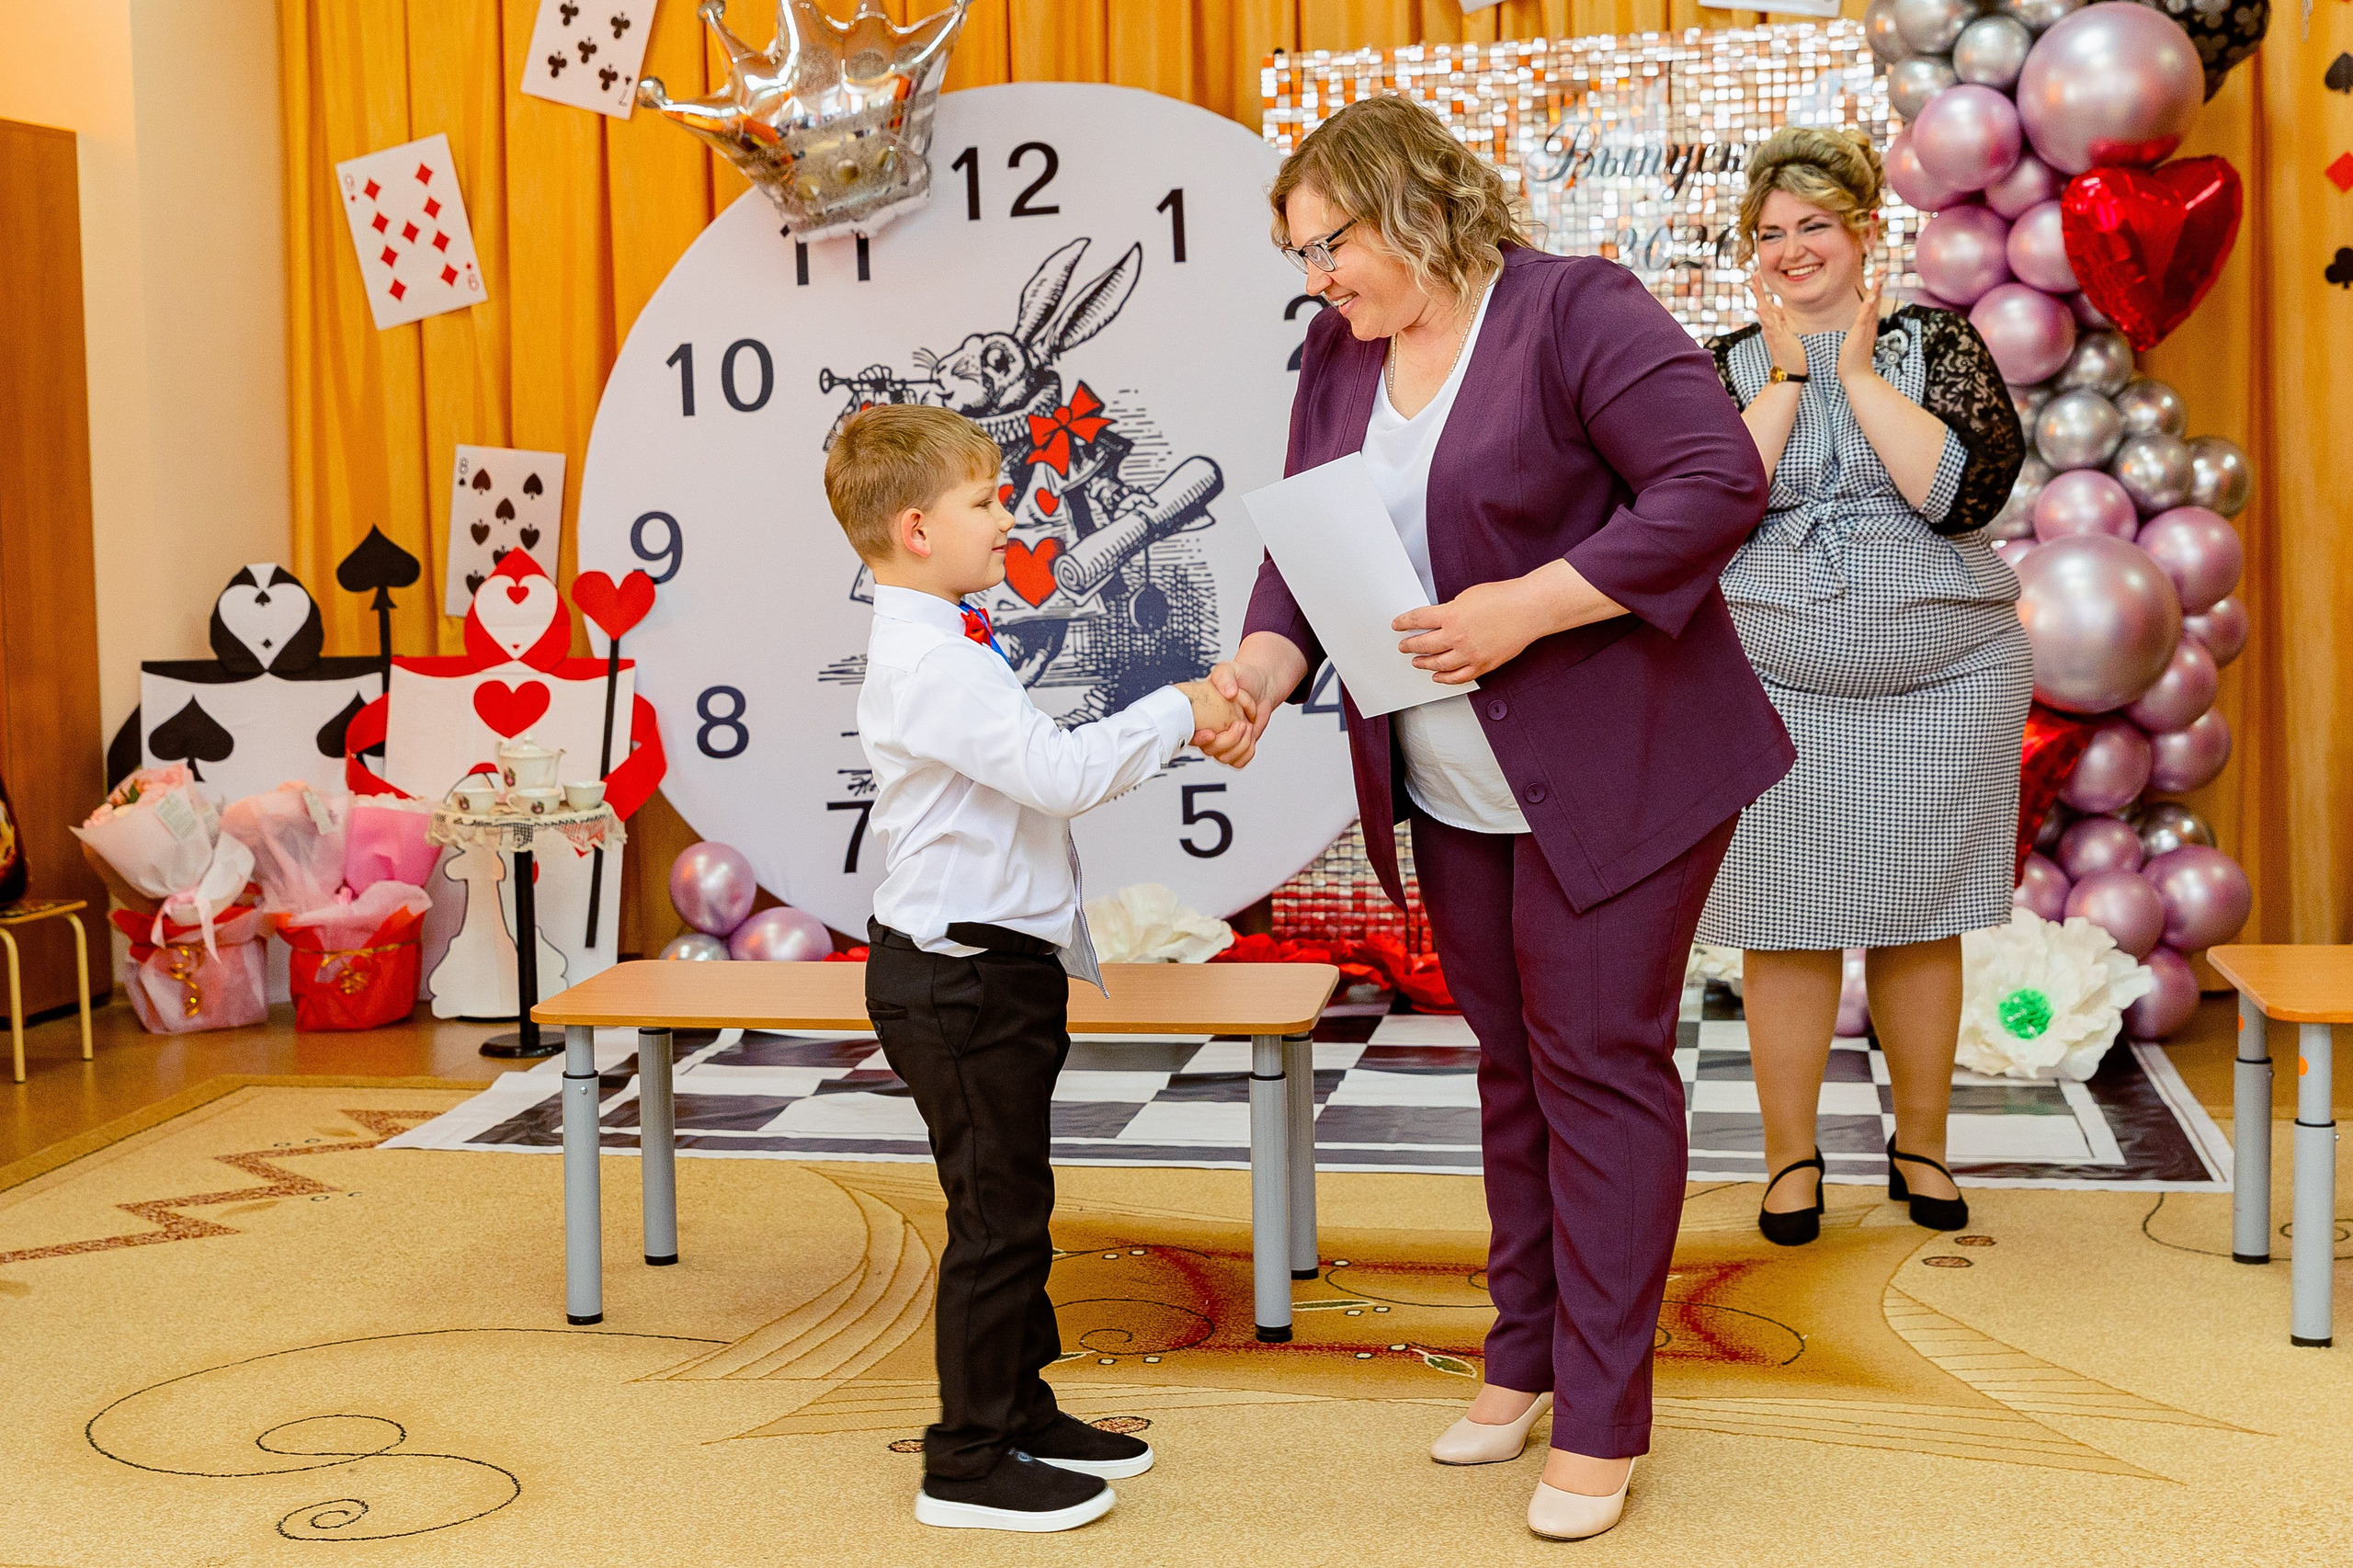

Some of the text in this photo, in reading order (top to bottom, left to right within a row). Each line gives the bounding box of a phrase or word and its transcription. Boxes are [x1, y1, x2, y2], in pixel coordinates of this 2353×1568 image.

[951, 141, 1061, 221] 12
[1155, 187, 1187, 264] 1
[665, 338, 775, 417] 10
[631, 511, 683, 585] 9
[696, 685, 750, 760] 8
[1302, 661, 1348, 732] 4
[826, 801, 875, 874] 7
[1178, 782, 1233, 859] 5
